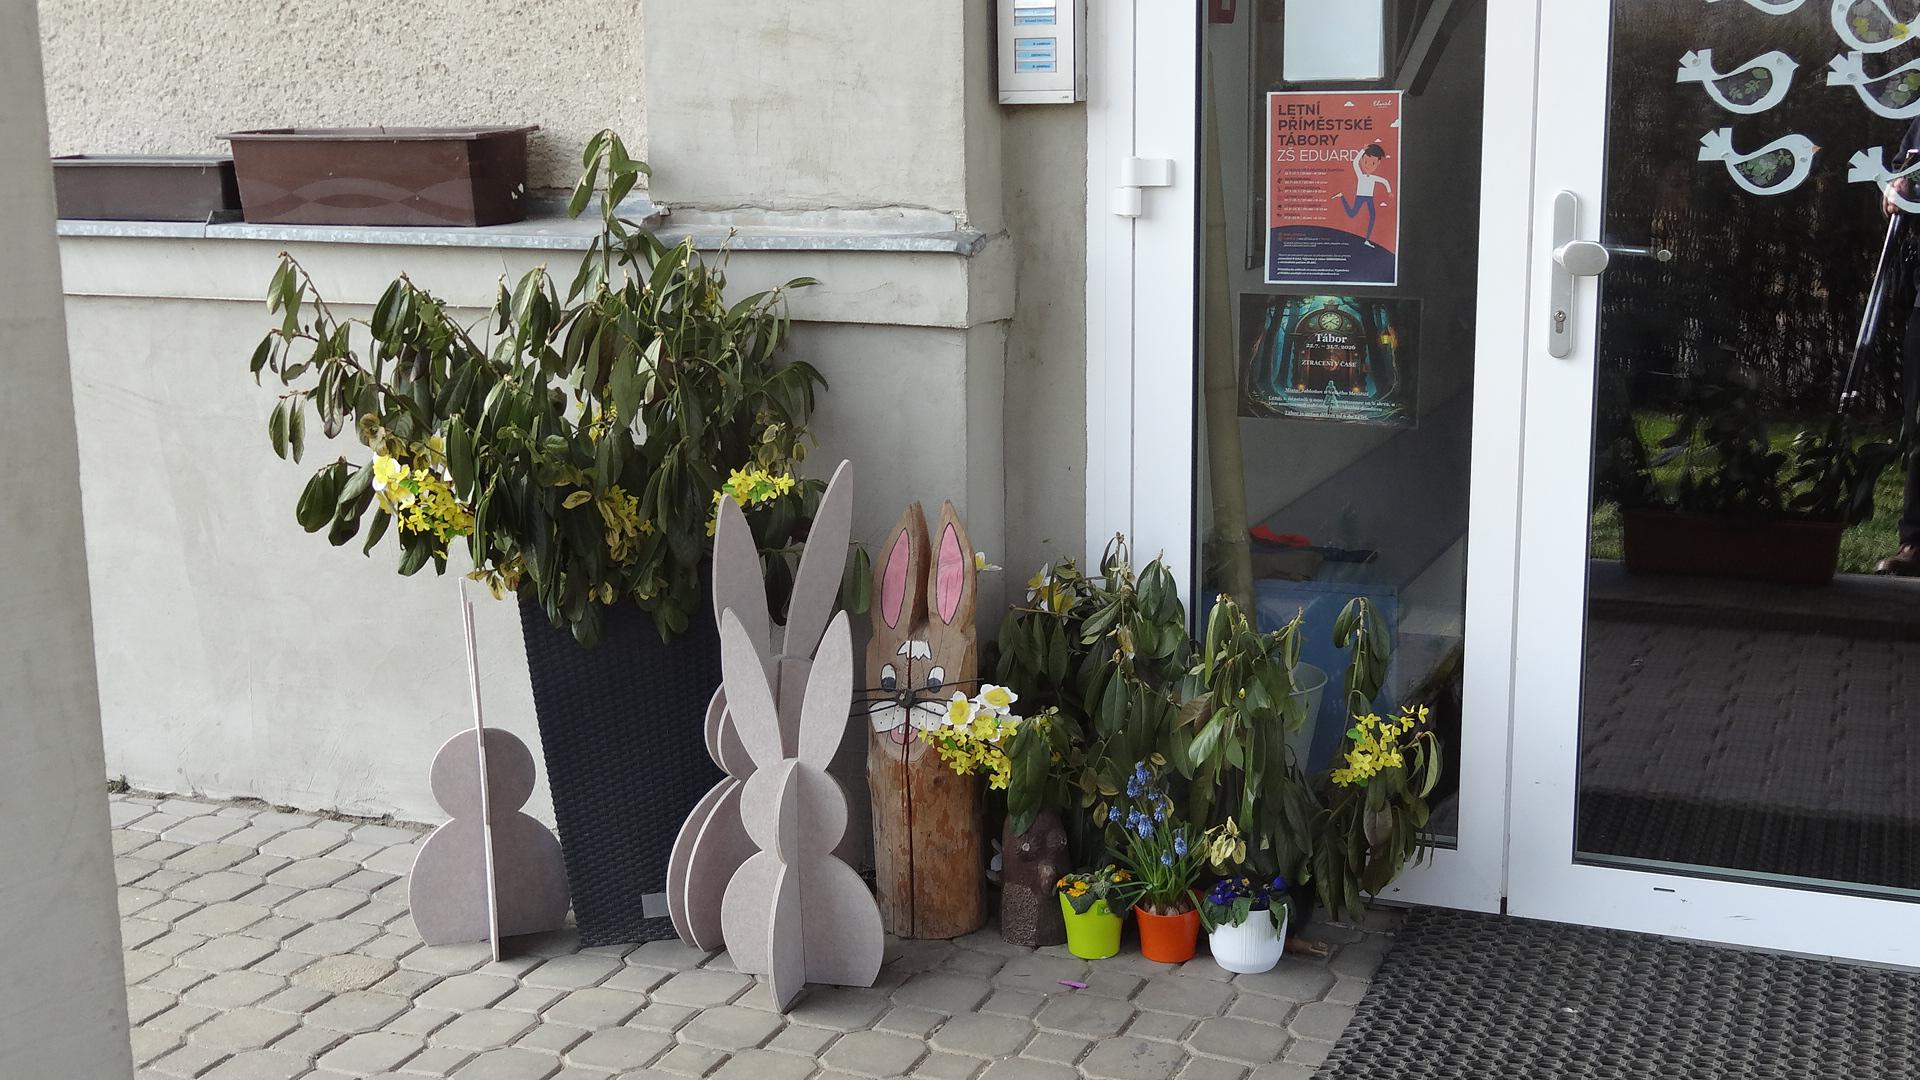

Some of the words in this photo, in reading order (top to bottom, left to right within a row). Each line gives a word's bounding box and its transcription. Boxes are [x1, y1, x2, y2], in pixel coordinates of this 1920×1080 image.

[1278, 101, 1321, 116] LETNÍ
[1278, 116, 1373, 131] PŘÍMĚSTSKÉ
[1277, 132, 1339, 146] TÁBORY
[1277, 147, 1295, 162] ZŠ
[1300, 149, 1359, 162] EDUARD
[1315, 333, 1348, 343] Tábor
